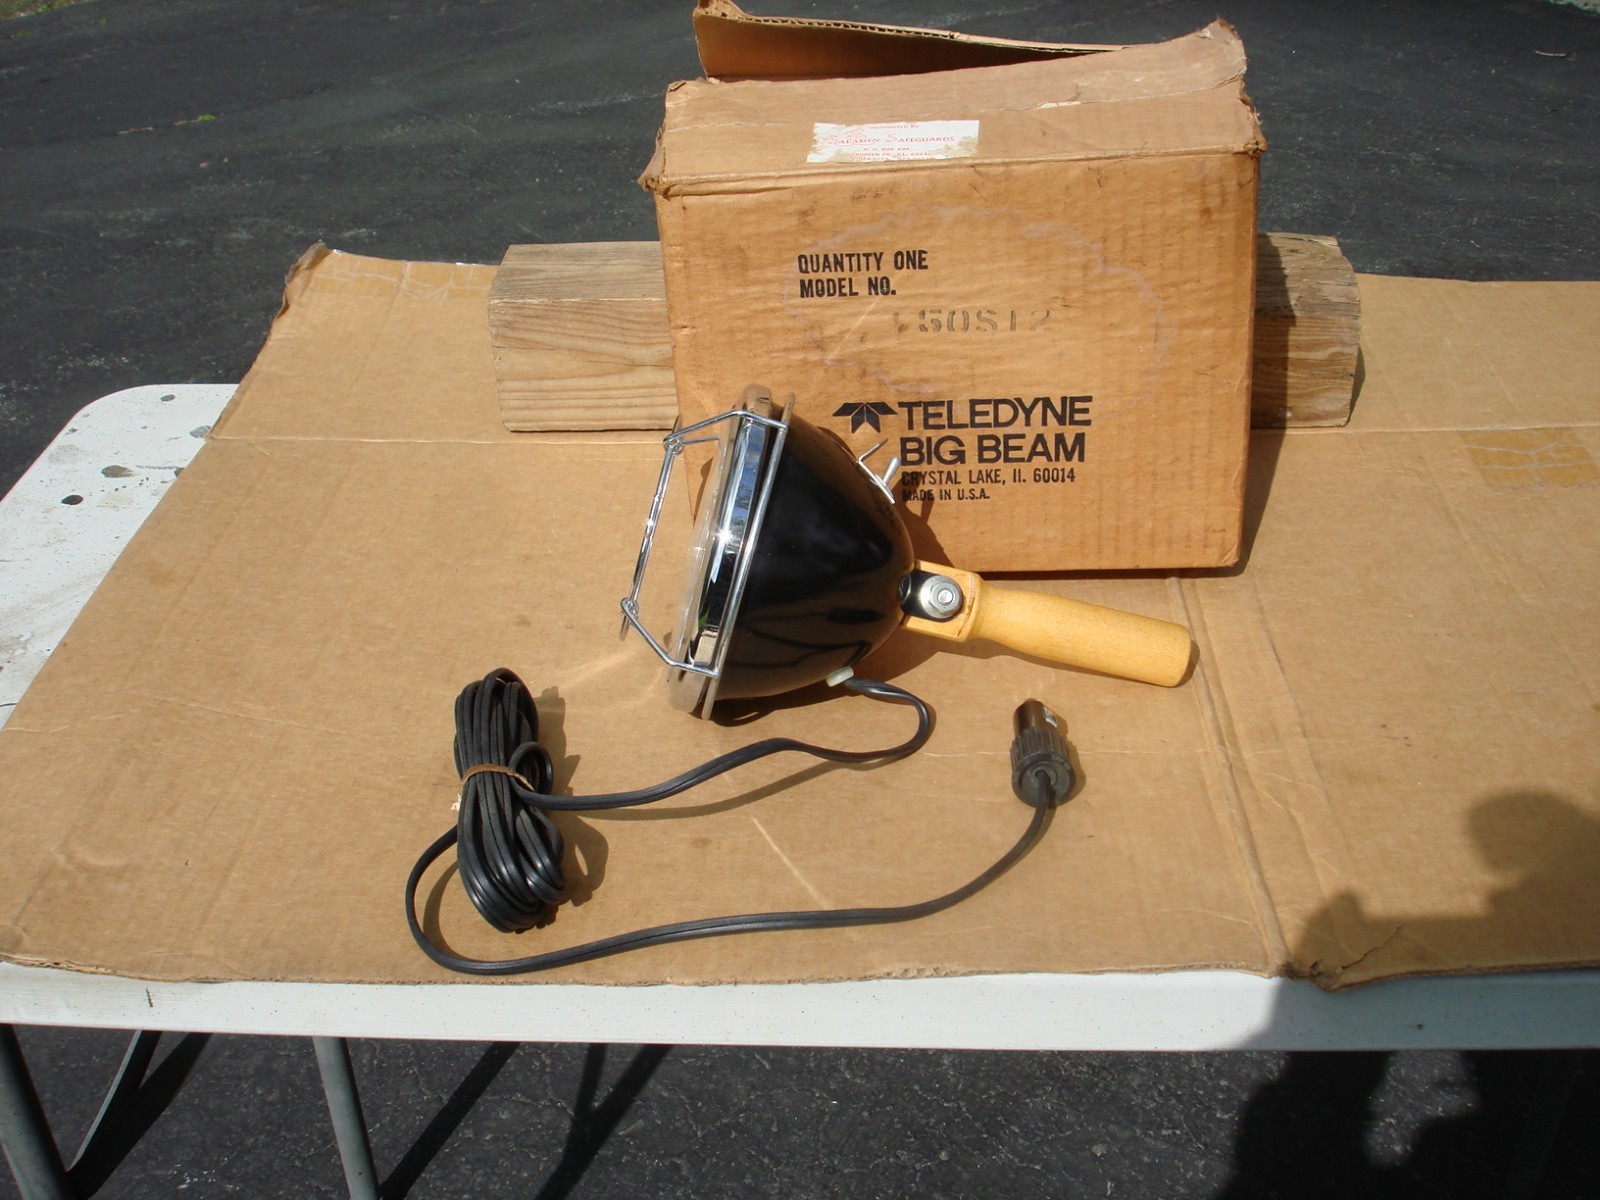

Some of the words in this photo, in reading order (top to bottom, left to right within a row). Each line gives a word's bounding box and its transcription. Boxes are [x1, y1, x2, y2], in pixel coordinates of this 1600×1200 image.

[885, 132, 956, 143] SAFEGUARDS
[797, 251, 884, 274] QUANTITY
[893, 249, 929, 270] ONE
[799, 278, 858, 298] MODEL
[867, 276, 897, 296] NO.
[897, 395, 1093, 431] TELEDYNE
[900, 434, 967, 467] BIG
[977, 432, 1086, 464] BEAM
[902, 470, 962, 487] CRYSTAL
[968, 469, 1006, 486] LAKE,
[1033, 467, 1076, 484] 60014
[902, 488, 934, 502] MADE
[939, 488, 951, 501] IN
[957, 488, 990, 500] U.S.A.
